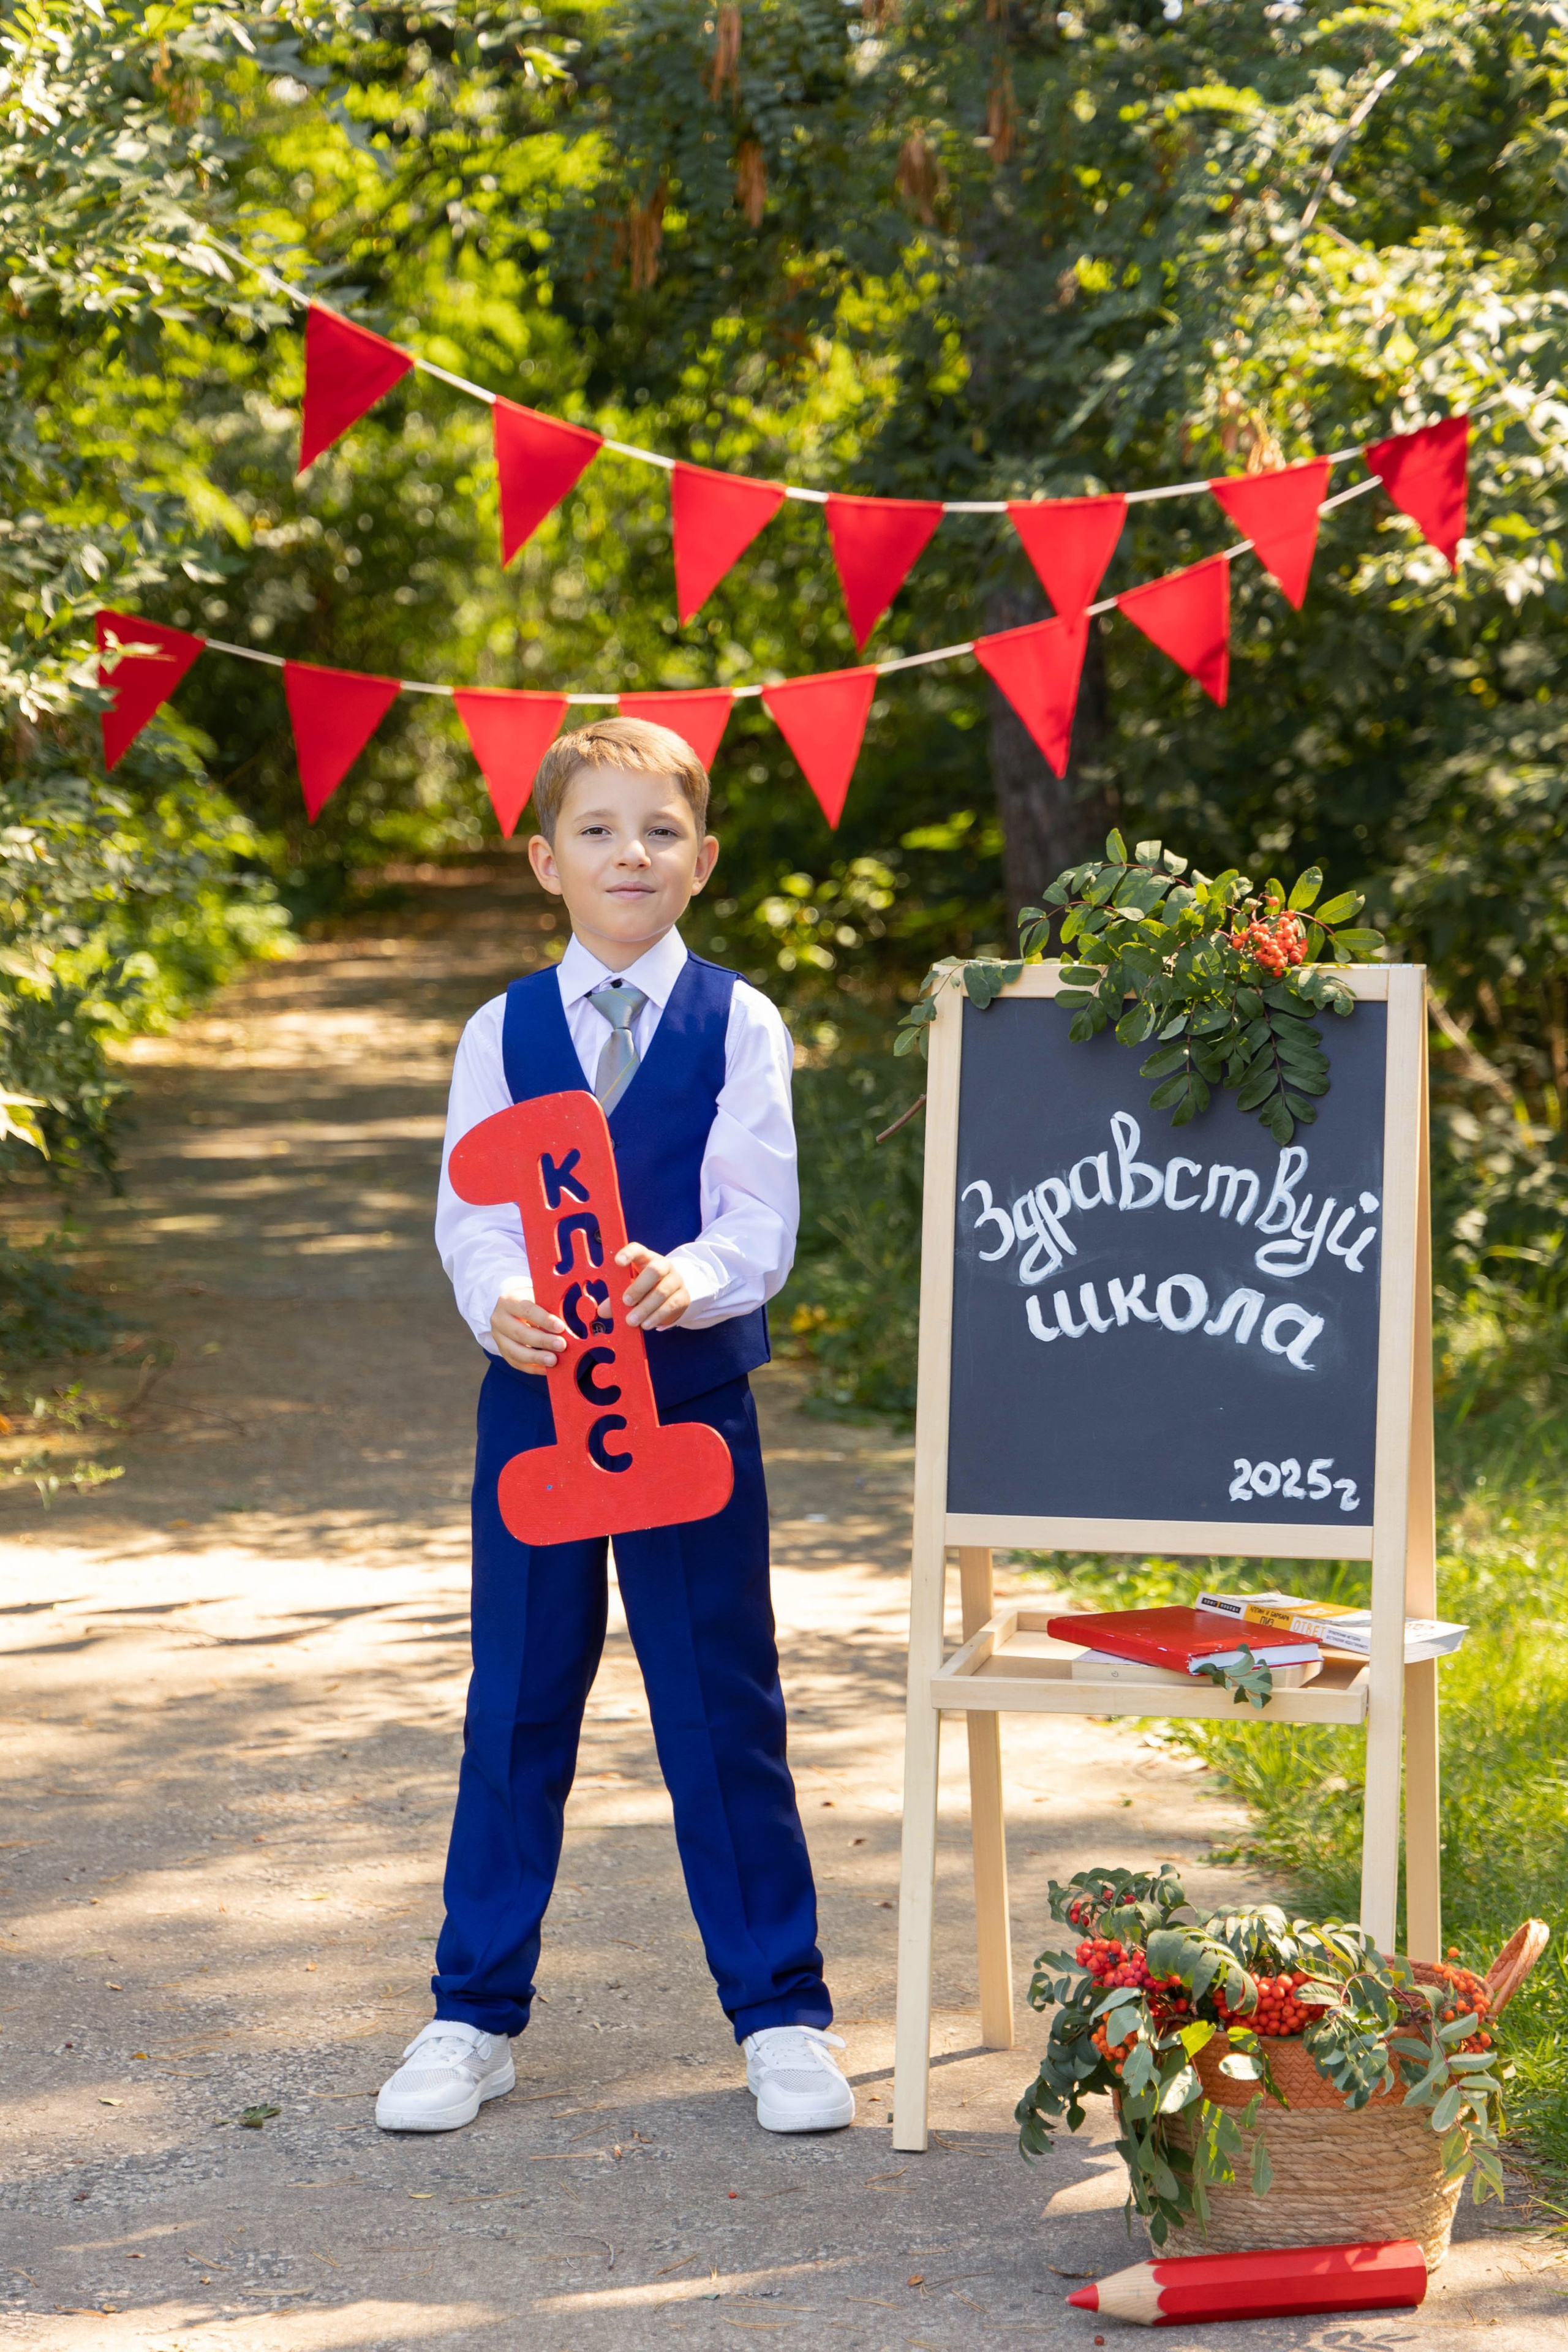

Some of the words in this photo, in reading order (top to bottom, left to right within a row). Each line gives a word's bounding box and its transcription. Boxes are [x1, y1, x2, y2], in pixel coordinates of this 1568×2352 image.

[961, 1110, 1379, 1284] Здравствуй
[1025, 1273, 1325, 1371] школа
[1294, 1619, 1327, 1638] ОТВЕТ
